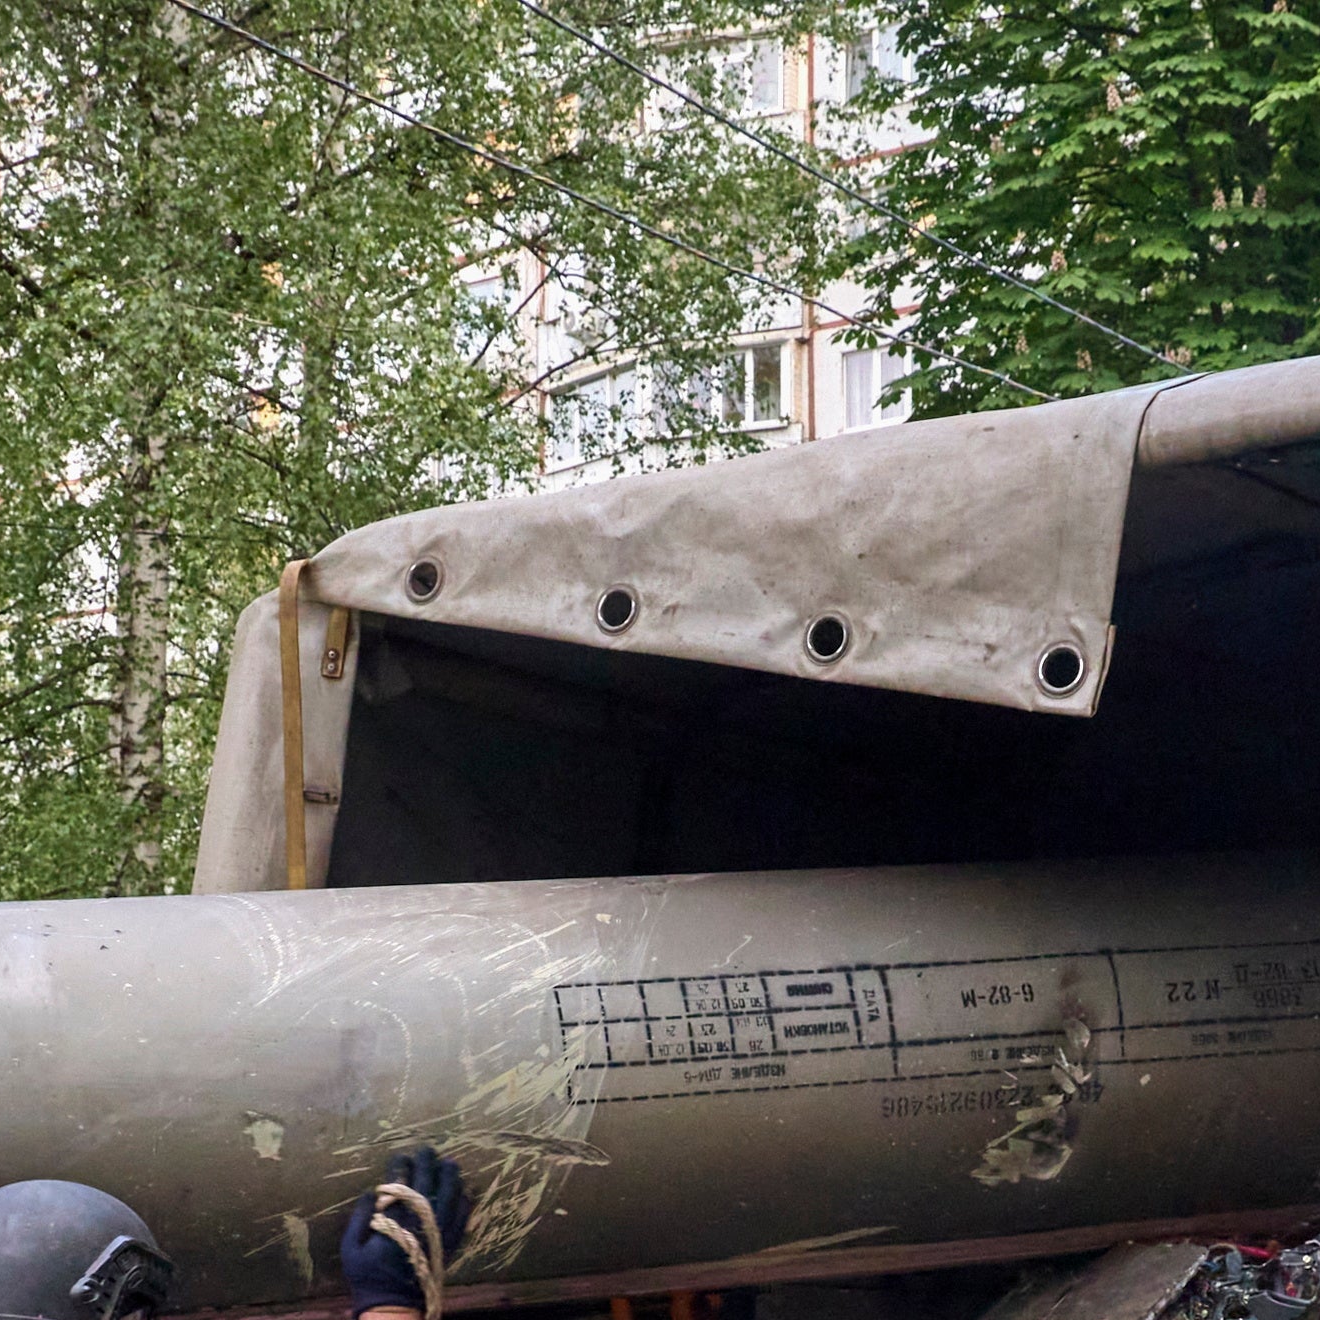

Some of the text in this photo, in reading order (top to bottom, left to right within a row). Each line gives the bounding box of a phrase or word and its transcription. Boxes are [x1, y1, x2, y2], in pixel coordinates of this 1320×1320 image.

[961, 983, 1034, 1009] 6-82-М
[1165, 981, 1197, 1003] 22
[862, 989, 881, 1023] ДАТА
[784, 1021, 850, 1039] УСТАНОВКИ
